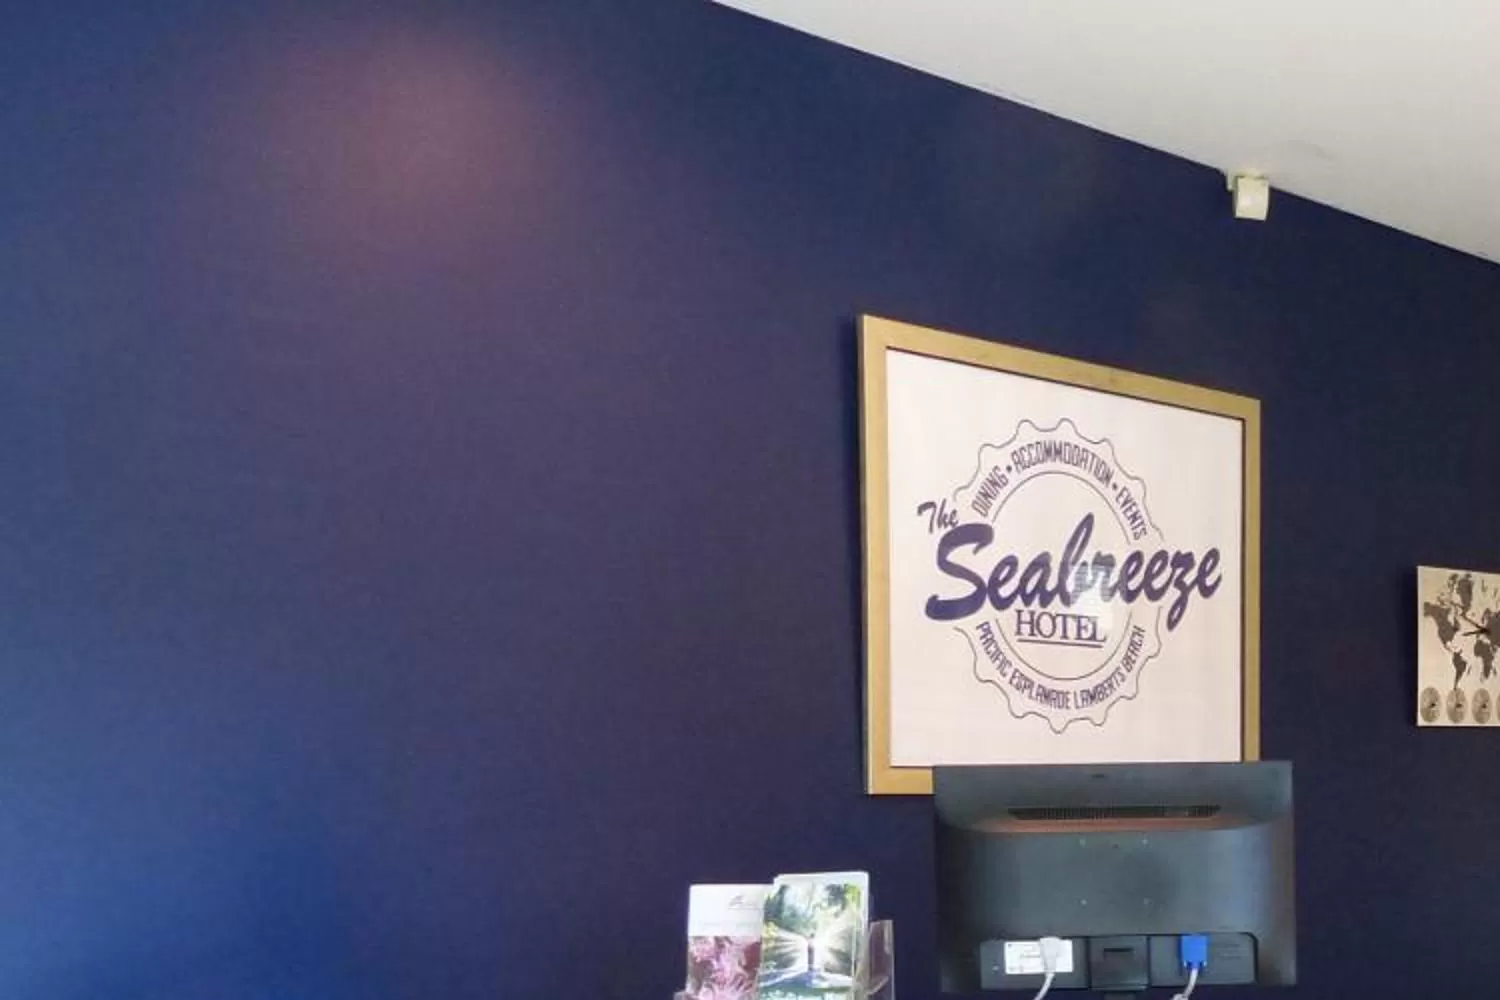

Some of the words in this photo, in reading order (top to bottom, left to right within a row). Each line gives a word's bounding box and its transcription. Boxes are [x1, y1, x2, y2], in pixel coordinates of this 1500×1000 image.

[917, 500, 958, 535] The
[971, 465, 1009, 518] DINING
[1010, 440, 1115, 487] ACCOMMODATION
[1115, 486, 1148, 541] EVENTS
[924, 512, 1222, 631] Seabreeze
[976, 620, 1013, 678] PACIFIC
[1008, 668, 1072, 710] ESPLANADE
[1073, 667, 1126, 709] LAMBERTS
[1121, 624, 1147, 674] BEACH
[1015, 609, 1107, 642] HOTEL
